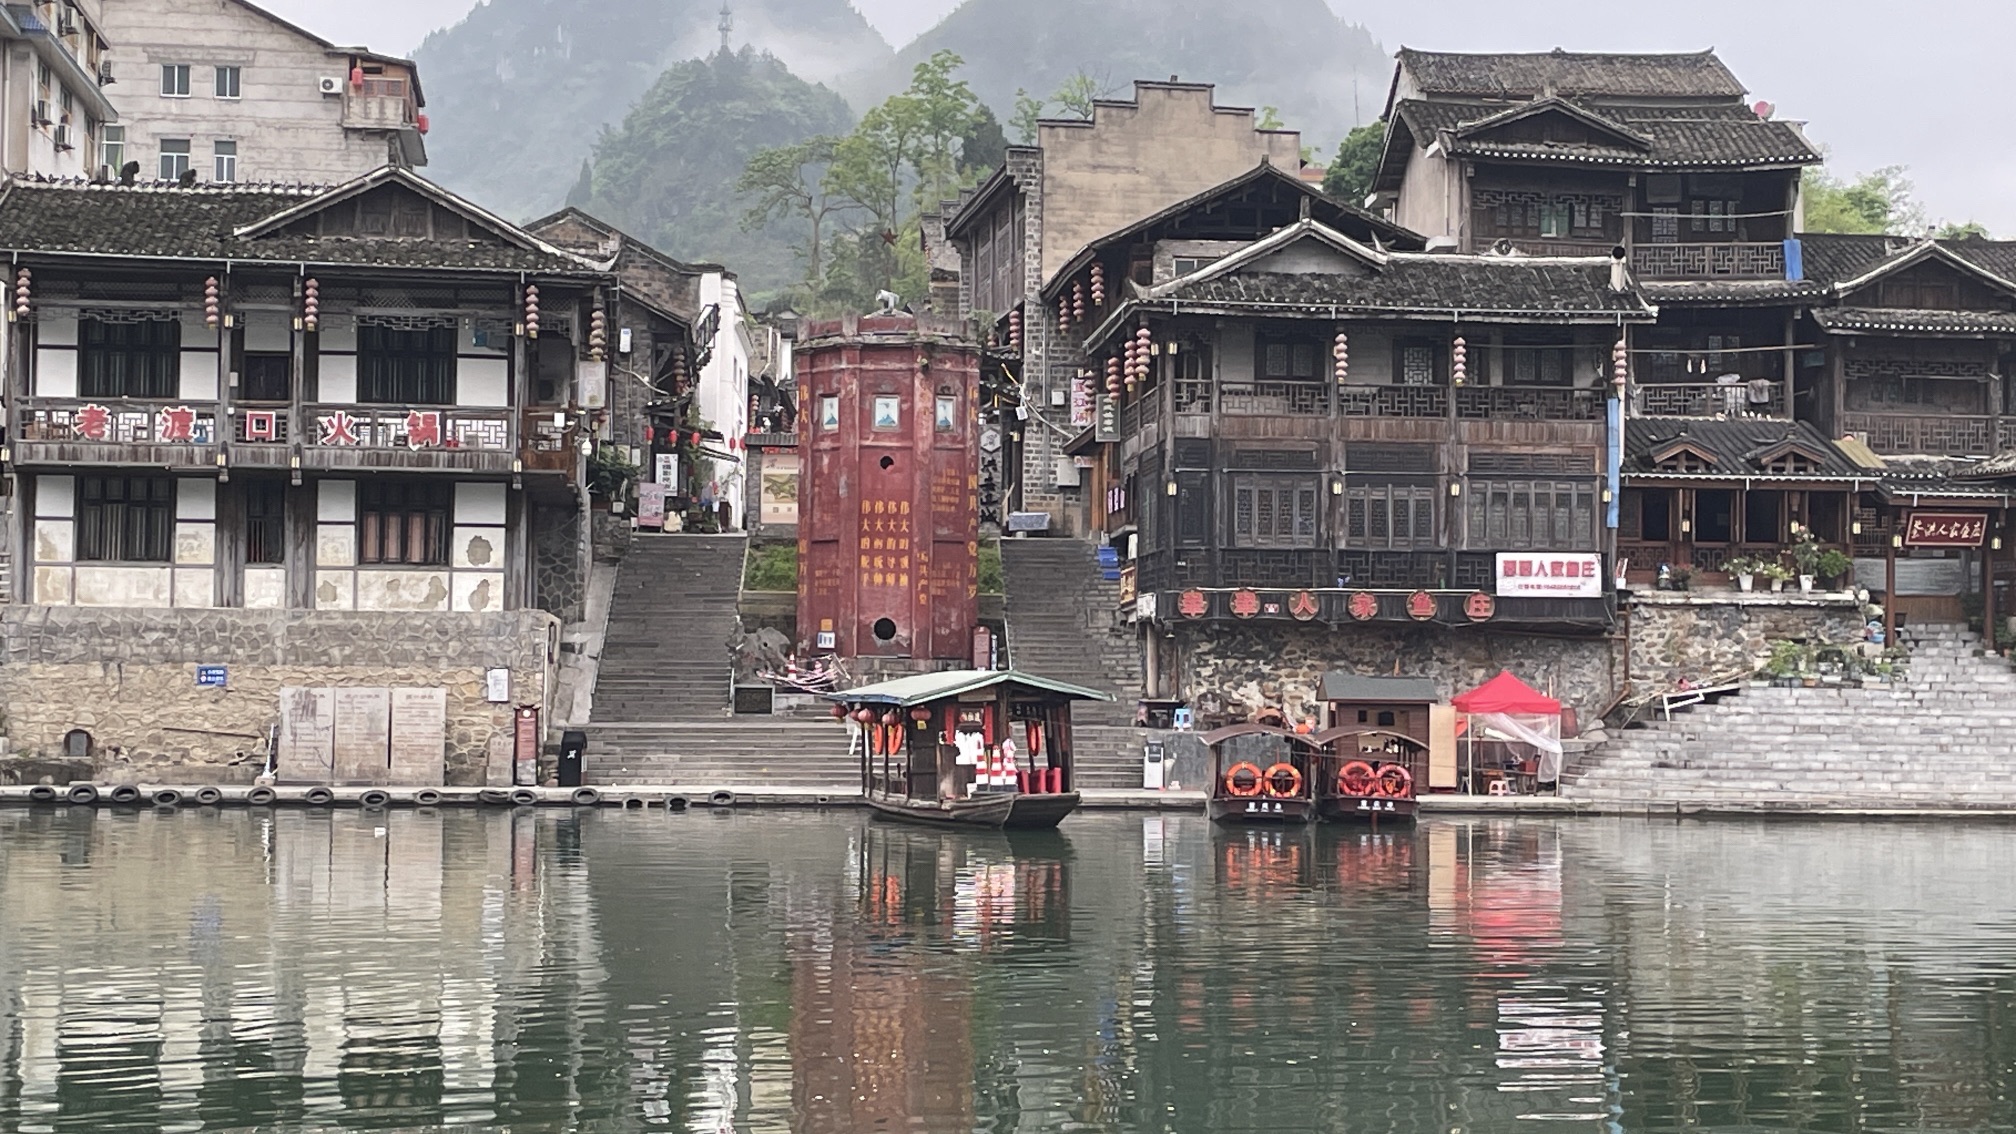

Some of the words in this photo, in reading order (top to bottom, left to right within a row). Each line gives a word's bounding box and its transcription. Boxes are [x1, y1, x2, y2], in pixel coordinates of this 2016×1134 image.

[74, 403, 442, 450] 老渡口火锅
